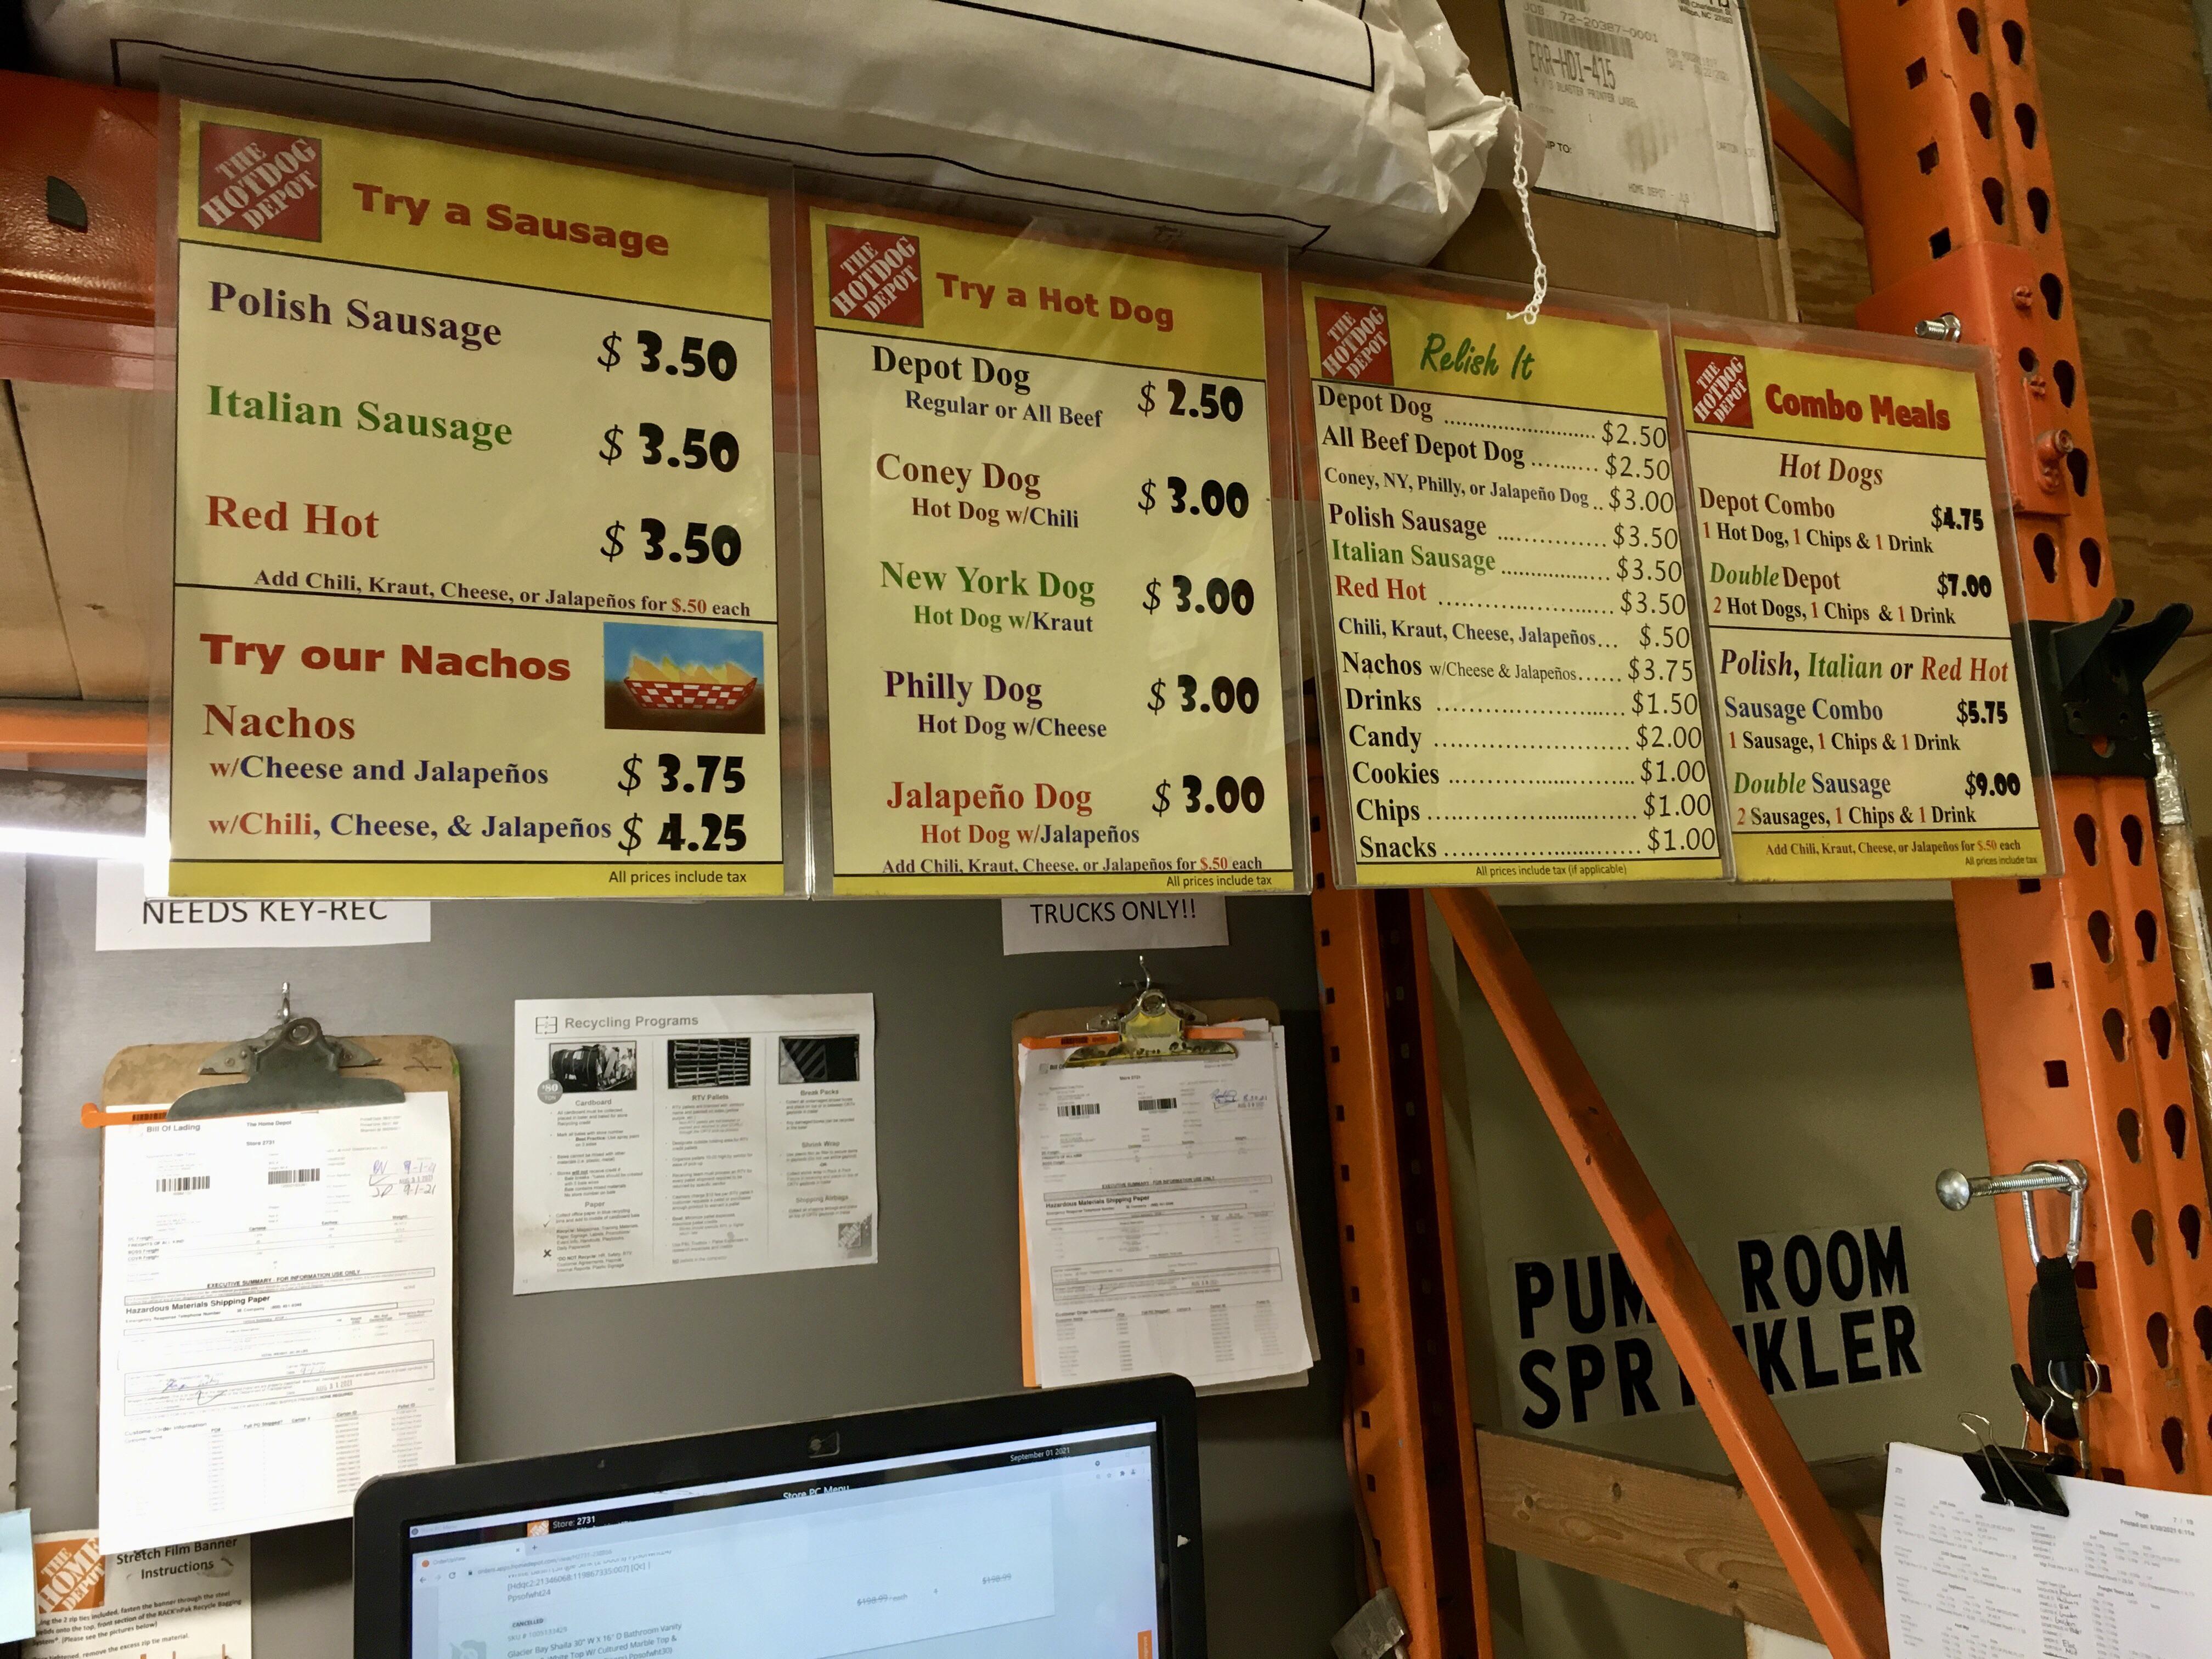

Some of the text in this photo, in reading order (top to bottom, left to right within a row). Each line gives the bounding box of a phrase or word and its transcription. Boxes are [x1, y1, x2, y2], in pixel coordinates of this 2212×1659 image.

[1560, 10, 1658, 43] 72-20387-0001
[1528, 40, 1616, 89] ERR-HDI-415
[215, 140, 267, 182] THE
[200, 137, 319, 226] HOTDOG
[241, 169, 320, 231] DEPOT
[353, 183, 668, 258] Try a Sausage
[936, 272, 1173, 332] Try a Hot Dog
[210, 281, 331, 325] Polish
[347, 299, 501, 351] Sausage
[637, 330, 737, 381] 3.50
[1420, 332, 1534, 380] Relish It
[209, 386, 511, 451] Italian Sausage
[906, 390, 1103, 427] Regular or All Beef
[1765, 384, 1950, 431] Combo Meals
[1325, 467, 1589, 507] Coney, NY, Philly, or Jalapeño Dog
[206, 496, 379, 538] Red Hot
[1699, 487, 1984, 532] Depot Combo $4.75
[254, 569, 751, 618] Add Chili, Kraut, Cheese, or Jalapeños for $.50 each
[880, 562, 1094, 607] New York Dog
[200, 634, 570, 681] Try our Nachos
[1720, 649, 2008, 682] Polish, Italian or Red Hot
[1345, 689, 1697, 716] Drinks $1.50
[1725, 696, 2007, 726] Sausage Combo $5.75
[203, 704, 354, 740] Nachos
[1350, 724, 1701, 753] Candy $2.00
[887, 782, 1092, 816] Jalapeño Dog
[1734, 771, 2020, 799] Double Sausage $9.00
[922, 825, 1139, 848] Hot Dog w/Jalapeños
[1361, 827, 1715, 857] Snacks $1.00
[1476, 864, 1627, 877] All prices include tax (if applicable)
[143, 901, 388, 924] NEEDS KEY-REC
[1030, 899, 1195, 923] TRUCKS ONLY!!
[565, 1015, 698, 1030] Recycling Programs
[796, 1194, 849, 1204] Shipping Airbags
[207, 1280, 241, 1289] EXECUTIVE
[242, 1277, 272, 1286] SUMMARY
[291, 1272, 330, 1281] INFORMATION
[1514, 1225, 1910, 1340] PUM ROOM
[126, 1295, 270, 1314] Hazardous Materials Shipping Paper
[1010, 1452, 1043, 1462] September
[1055, 1447, 1070, 1456] 2021
[552, 1516, 595, 1529] Store: 2731
[116, 1537, 238, 1565] Stretch Film Banner
[141, 1559, 215, 1580] Instructions
[121, 1605, 141, 1615] fasten
[154, 1599, 176, 1608] banner
[177, 1593, 202, 1606] through
[512, 1618, 544, 1628] CANCELLED
[507, 1649, 533, 1658] Glacier
[550, 1642, 572, 1652] Shaila
[624, 1627, 659, 1639] Bathroom
[660, 1623, 682, 1633] Vanity
